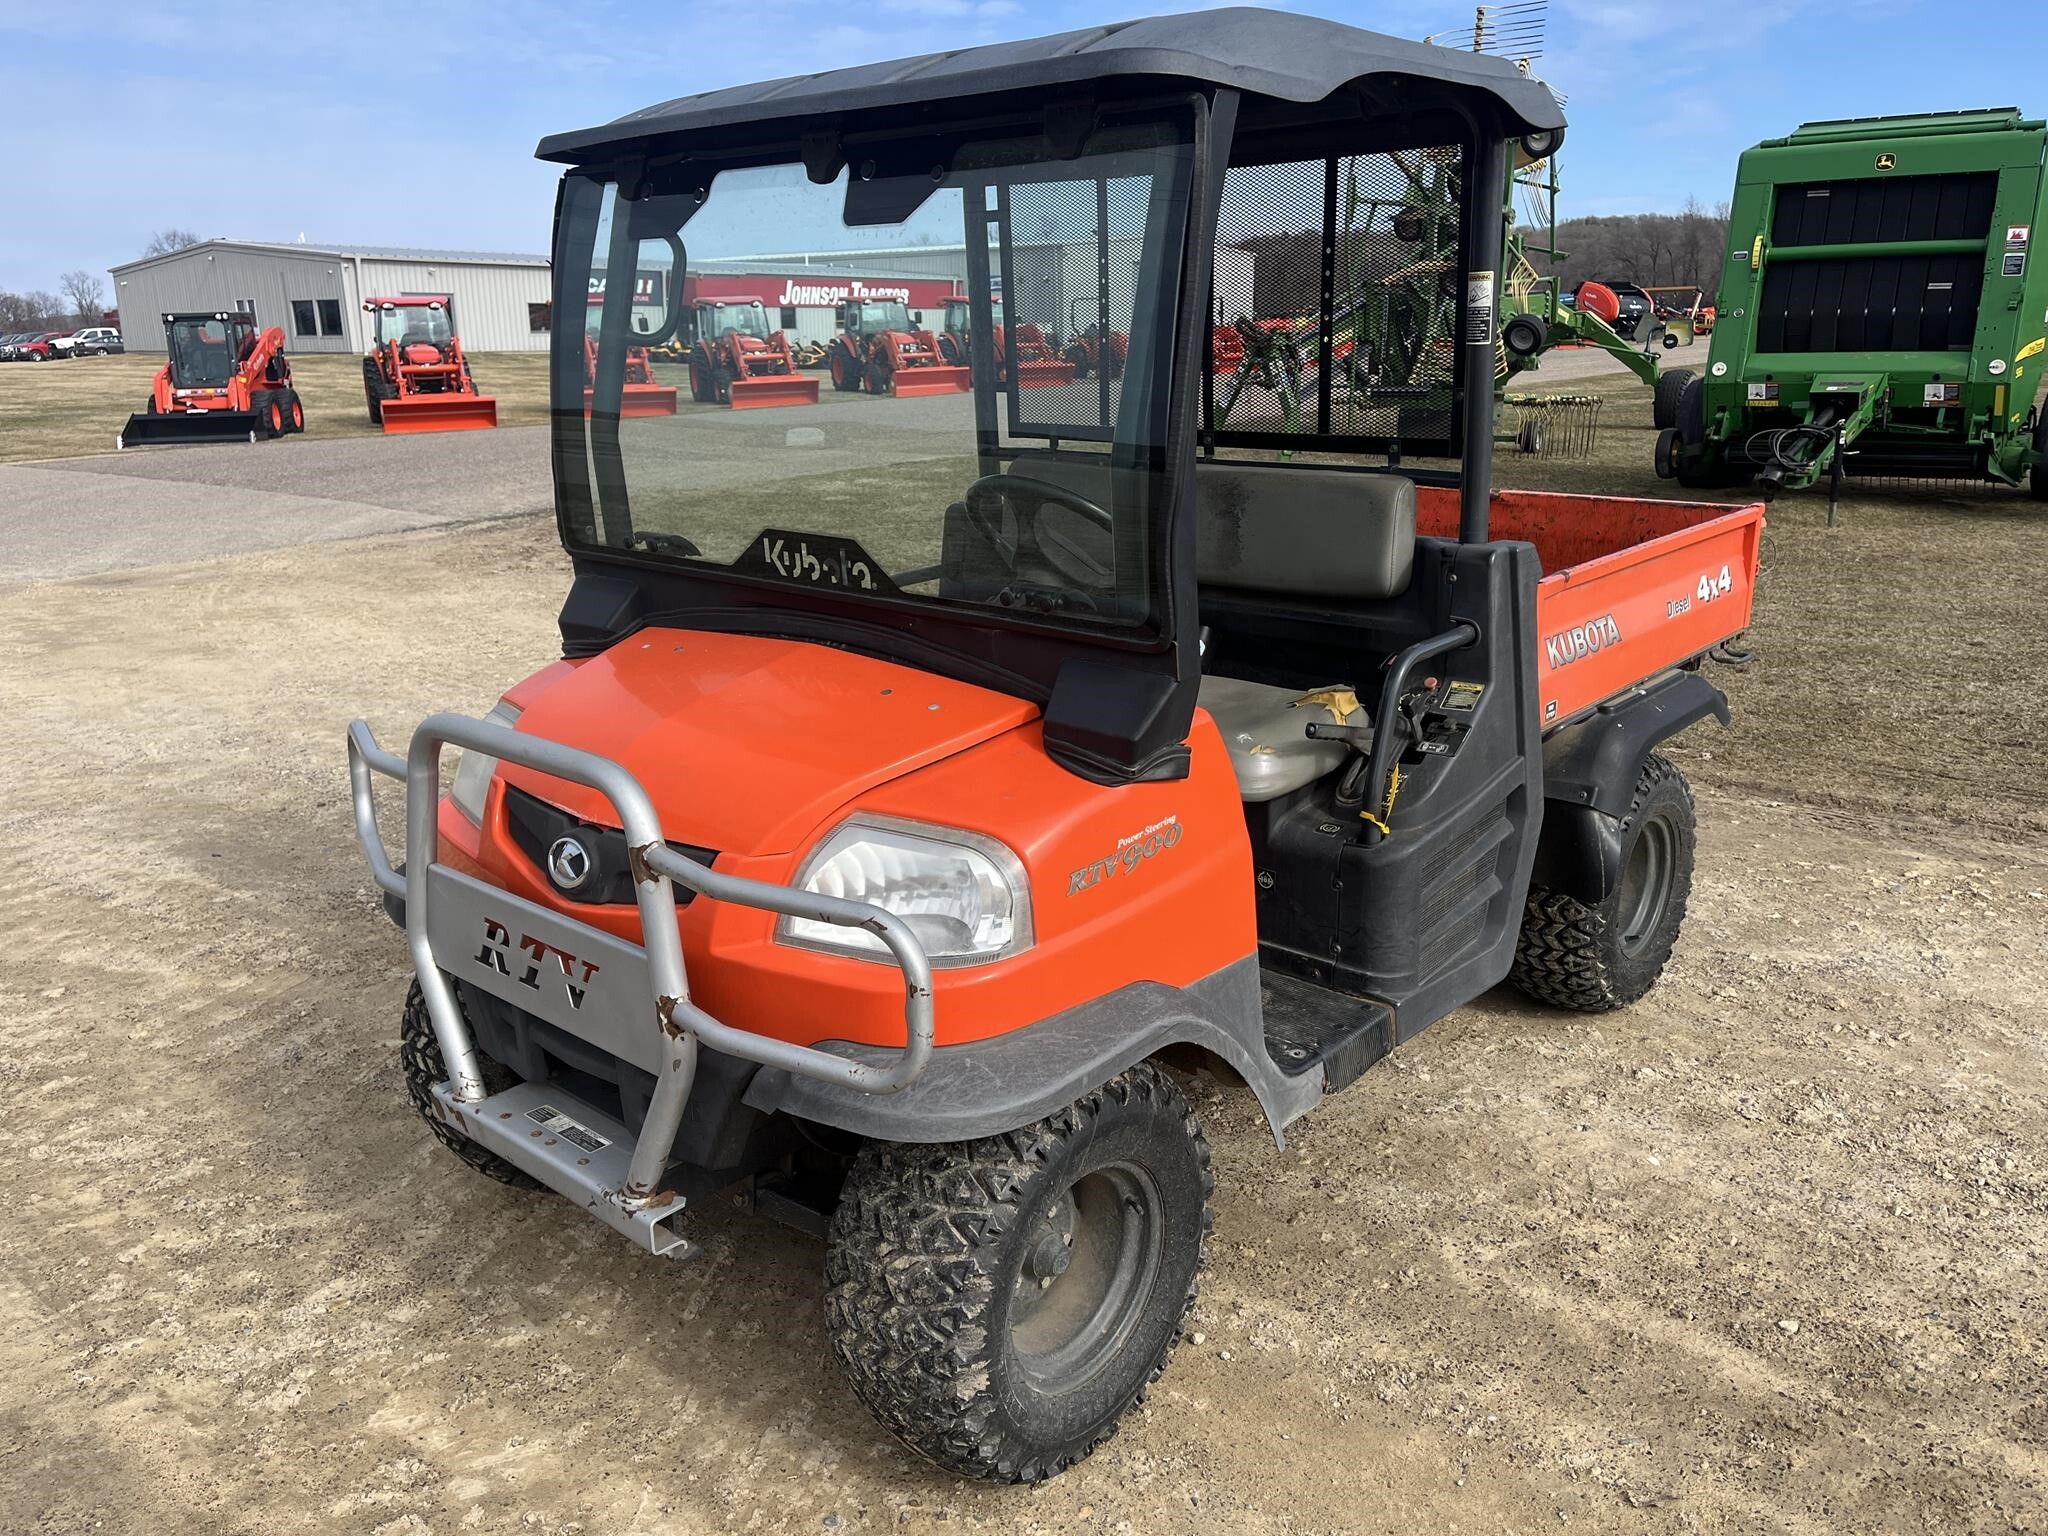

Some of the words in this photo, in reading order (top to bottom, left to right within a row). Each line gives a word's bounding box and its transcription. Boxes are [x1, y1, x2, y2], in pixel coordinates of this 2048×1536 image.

[779, 280, 849, 305] JOHNSON
[763, 537, 873, 590] Kubota
[1666, 593, 1692, 619] Diesel
[1696, 564, 1733, 603] 4x4
[1544, 614, 1622, 669] KUBOTA
[1117, 831, 1144, 849] Power
[1144, 815, 1176, 836] Steering
[473, 916, 600, 1010] RTV
